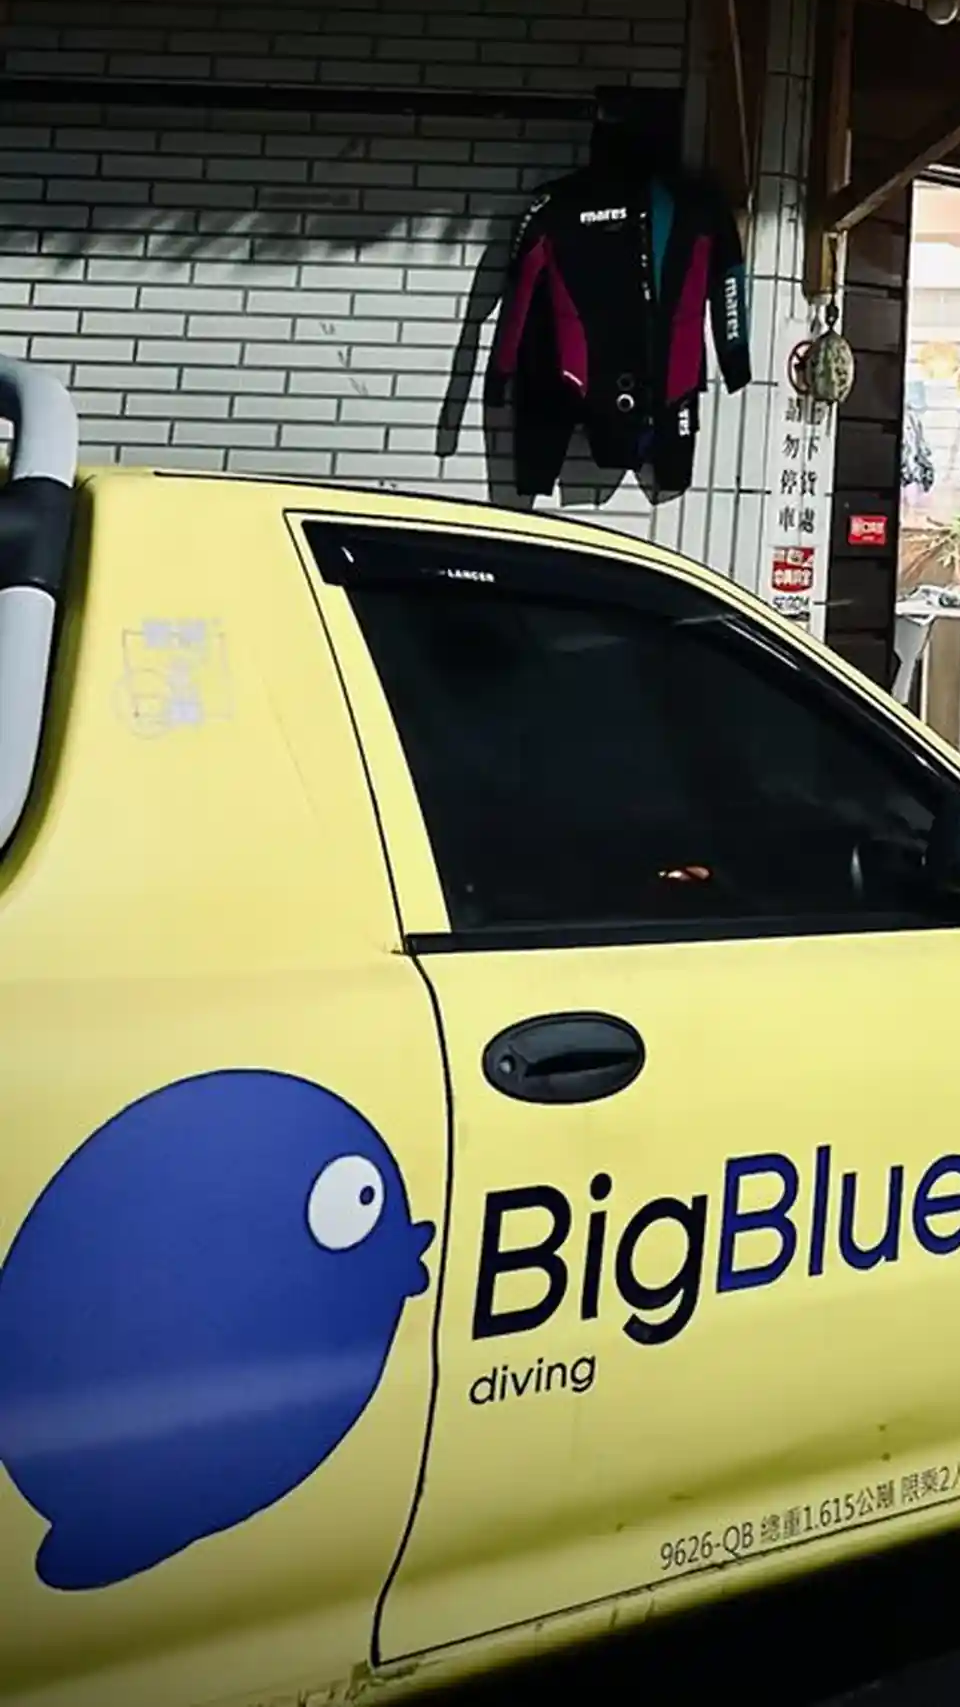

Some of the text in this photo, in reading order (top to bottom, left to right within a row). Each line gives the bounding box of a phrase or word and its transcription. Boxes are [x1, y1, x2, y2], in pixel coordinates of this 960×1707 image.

[579, 206, 628, 223] mares
[469, 1355, 596, 1405] diving
[659, 1521, 754, 1571] 9626-QB
